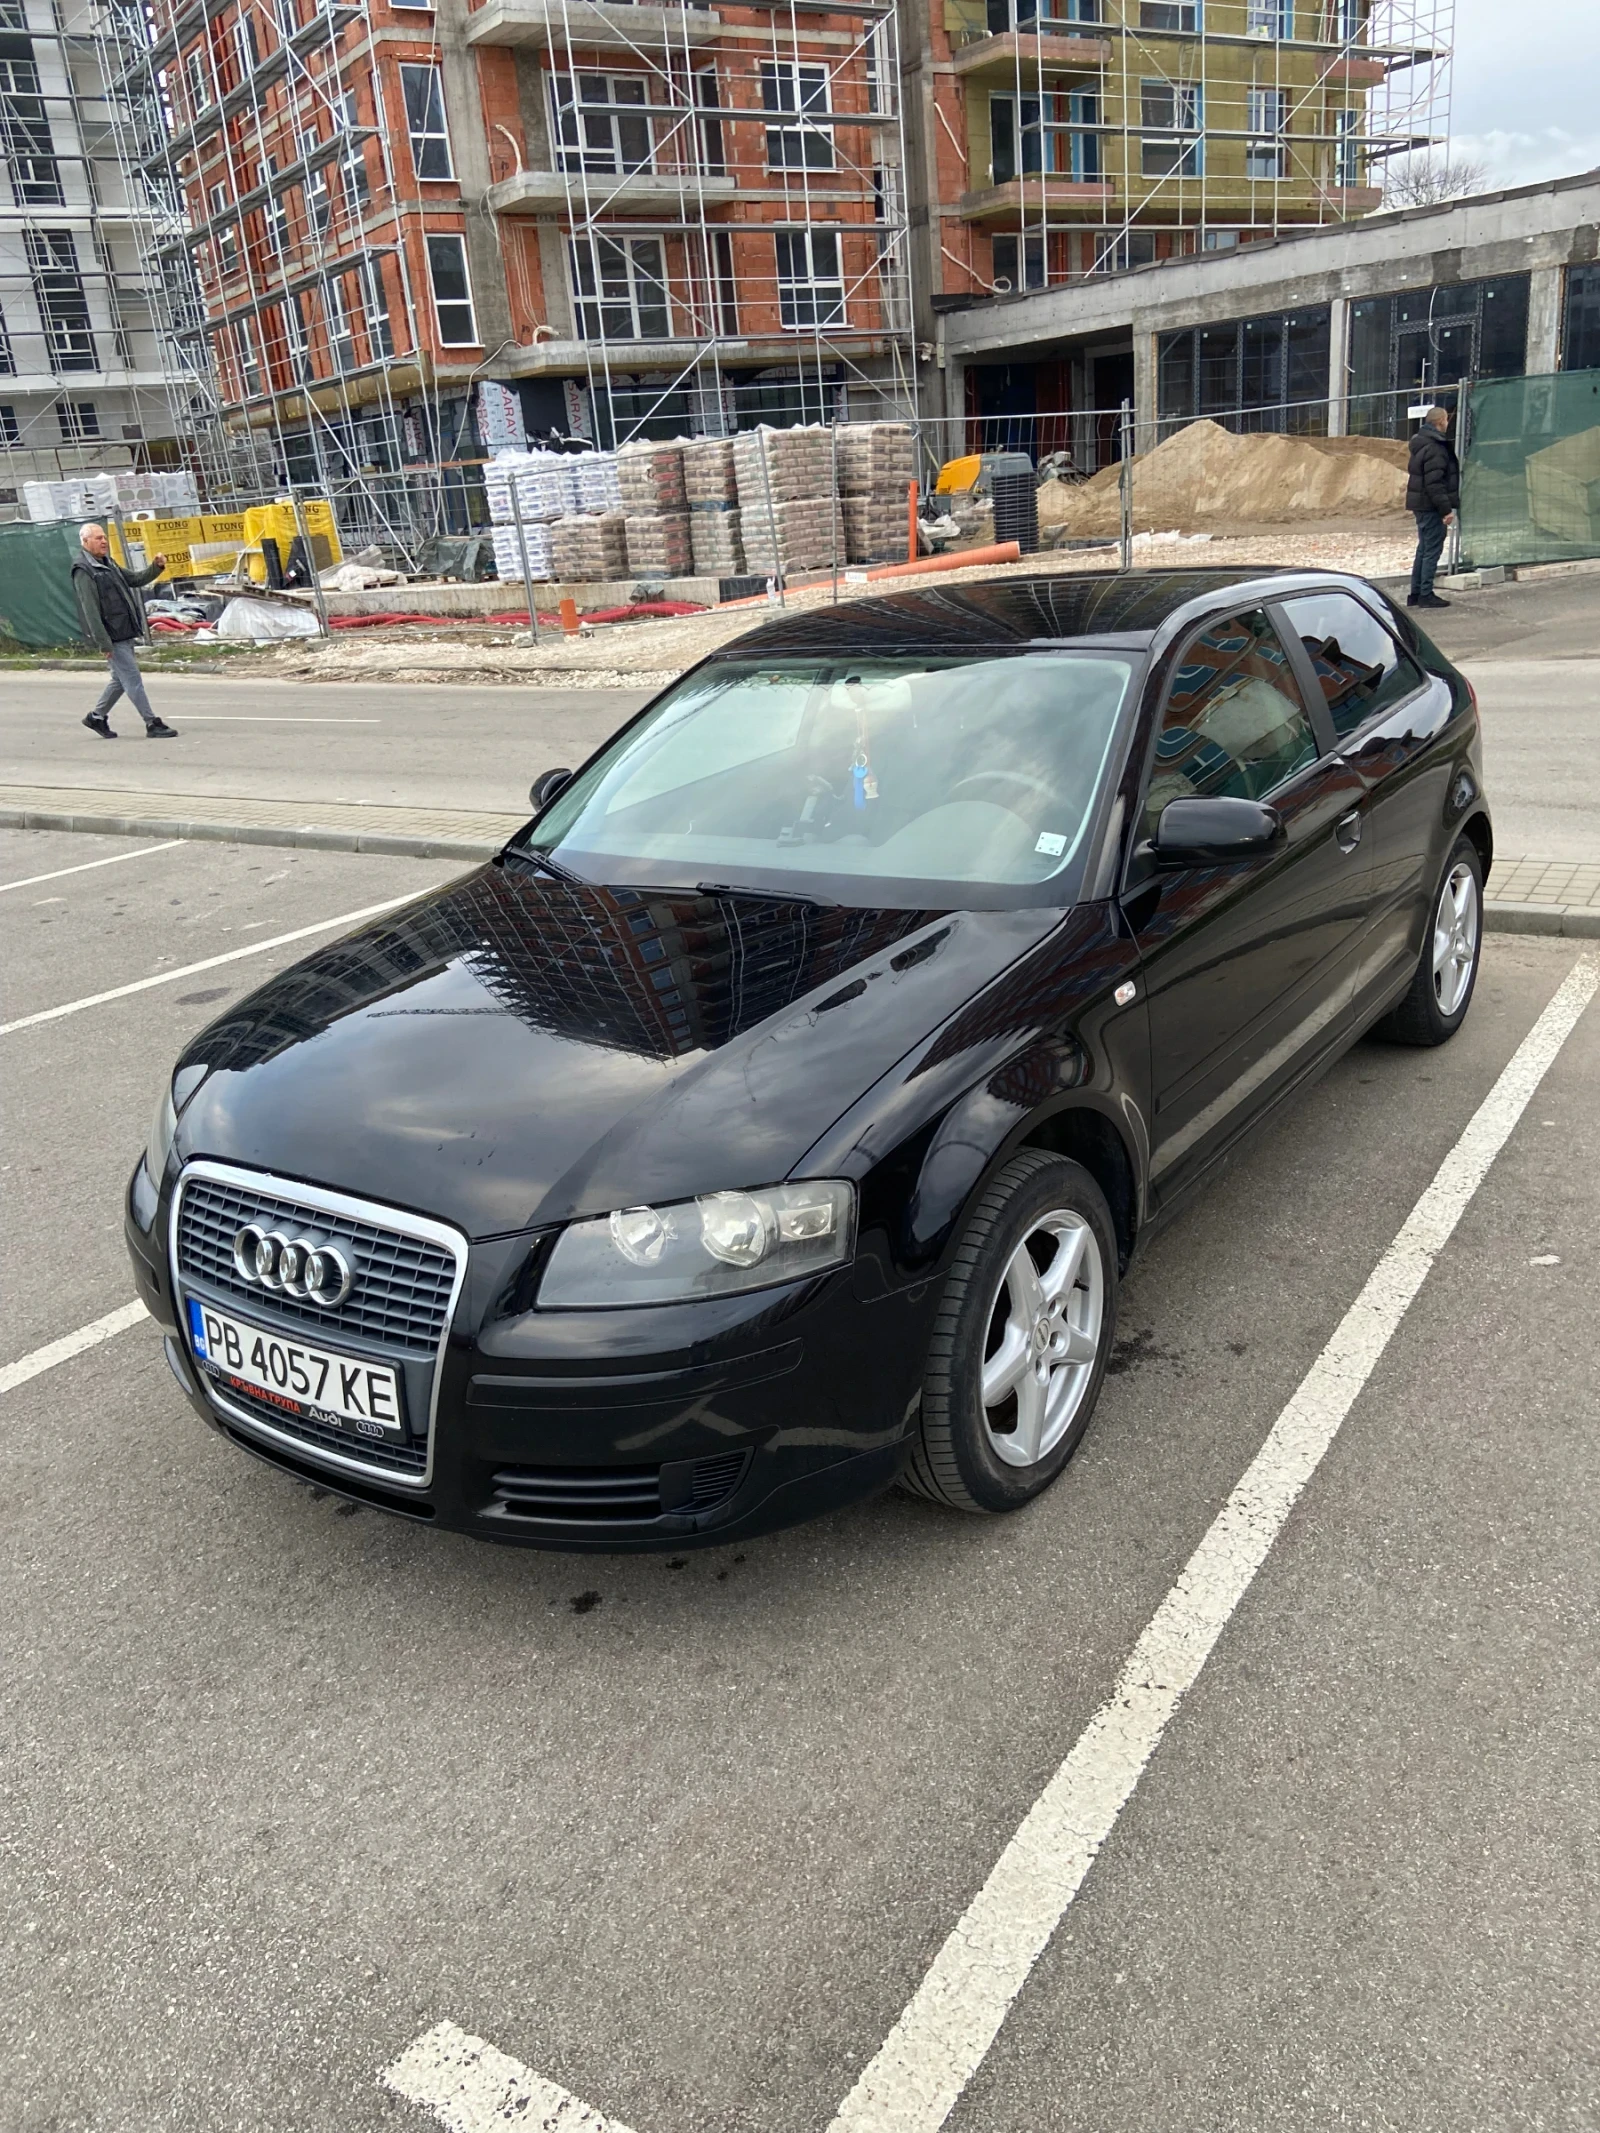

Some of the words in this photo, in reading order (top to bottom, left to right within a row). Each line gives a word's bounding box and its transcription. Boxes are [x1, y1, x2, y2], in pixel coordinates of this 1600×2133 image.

[567, 382, 584, 433] SARAY
[125, 527, 141, 536] TON
[156, 520, 189, 530] YTONG
[212, 522, 244, 531] YTONG
[194, 1334, 206, 1351] BG
[204, 1313, 244, 1370] PB
[251, 1337, 330, 1401] 4057
[340, 1363, 396, 1423] KE
[230, 1375, 268, 1400] КРЪВНА
[268, 1393, 301, 1413] ГРУПА
[308, 1406, 342, 1427] Audi
